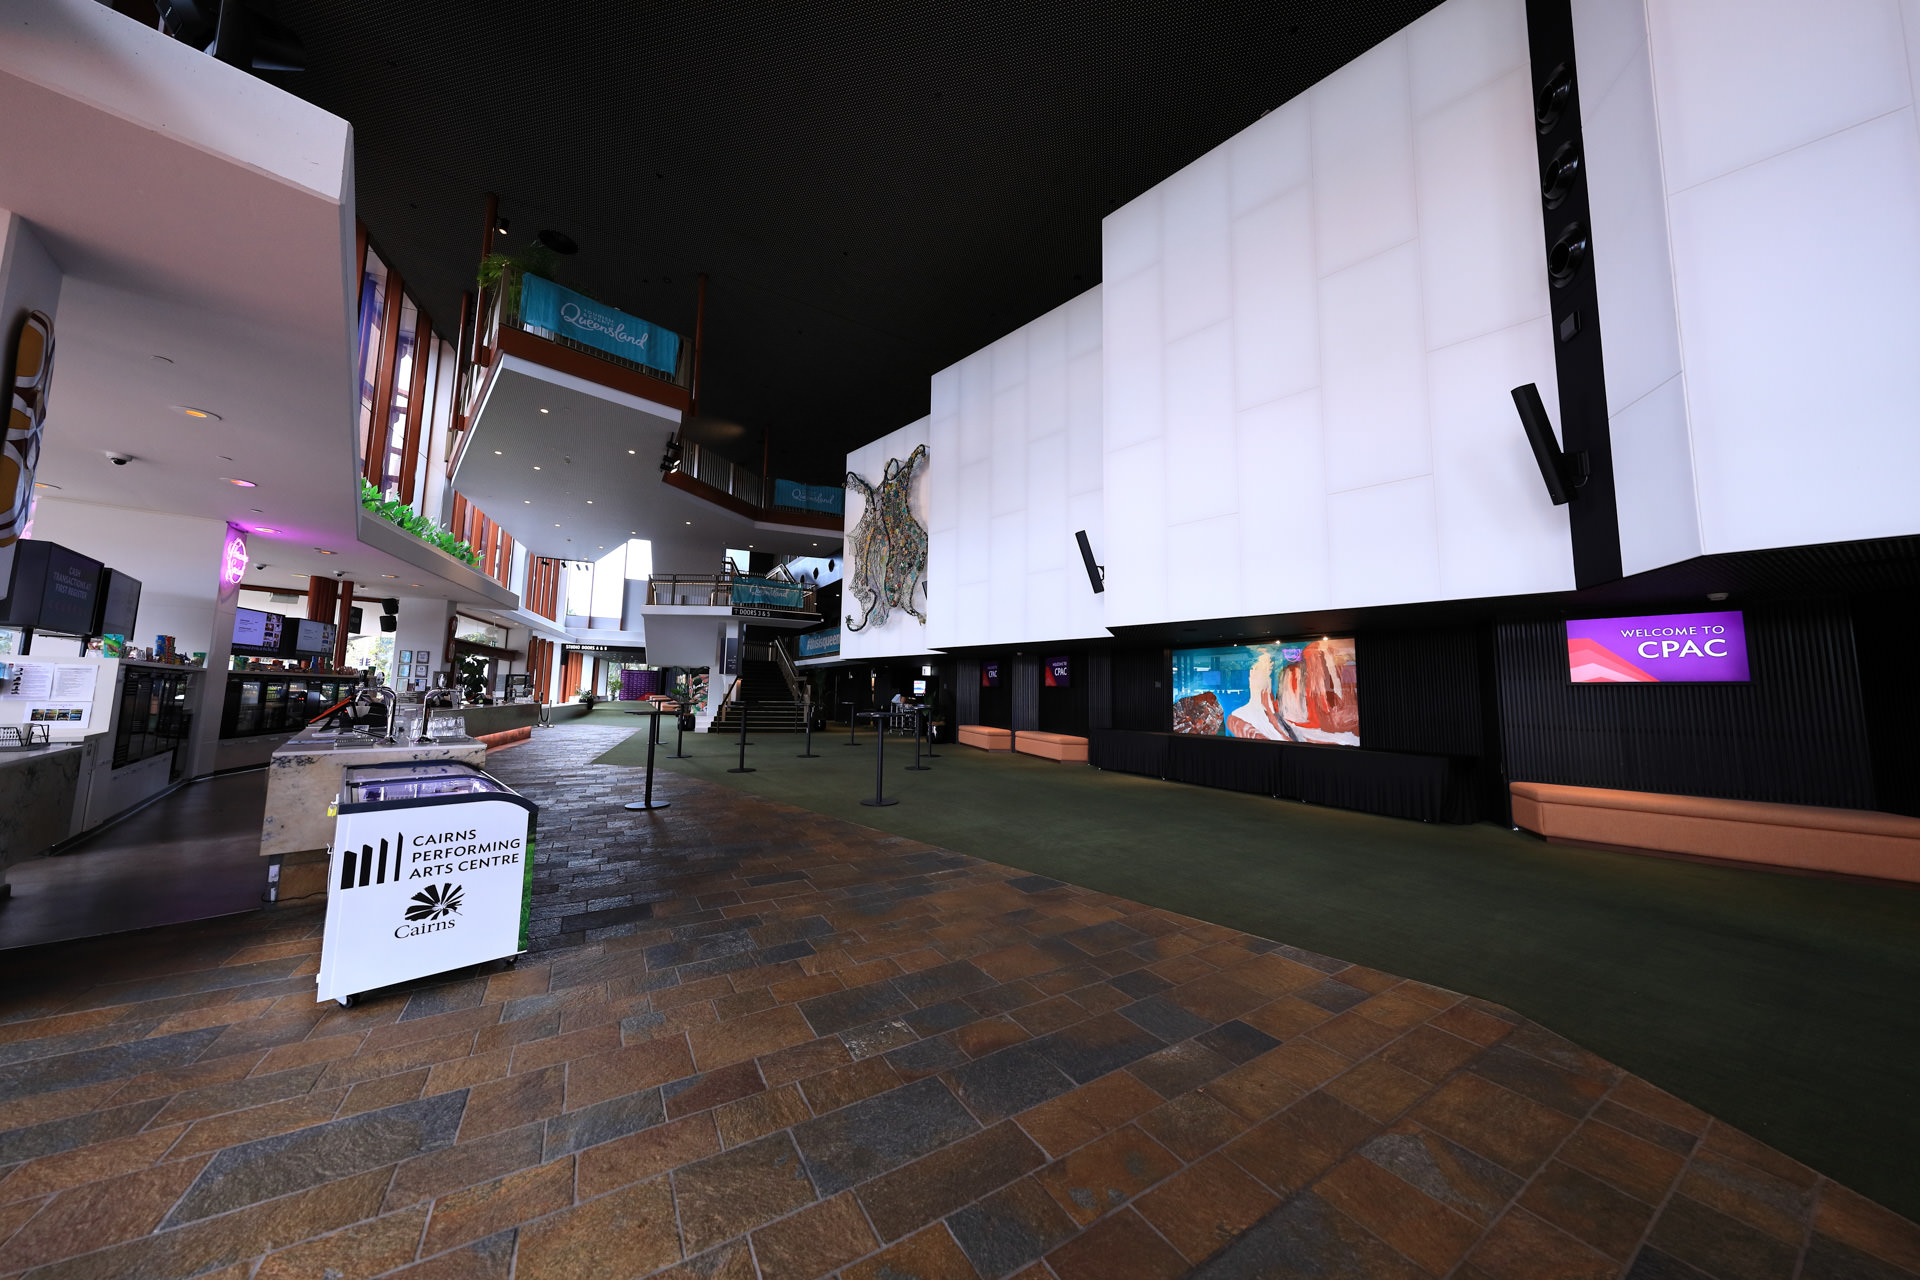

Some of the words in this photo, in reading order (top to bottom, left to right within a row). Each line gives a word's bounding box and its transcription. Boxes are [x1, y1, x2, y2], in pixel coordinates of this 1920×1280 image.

[560, 302, 648, 350] Queensland
[1620, 627, 1697, 638] WELCOME
[1701, 625, 1725, 635] TO
[1637, 639, 1728, 659] CPAC
[1054, 667, 1067, 676] CPAC
[412, 829, 477, 847] CAIRNS
[412, 838, 521, 863] PERFORMING
[408, 863, 453, 880] ARTS
[458, 853, 520, 871] CENTRE
[394, 919, 456, 939] Cairns
